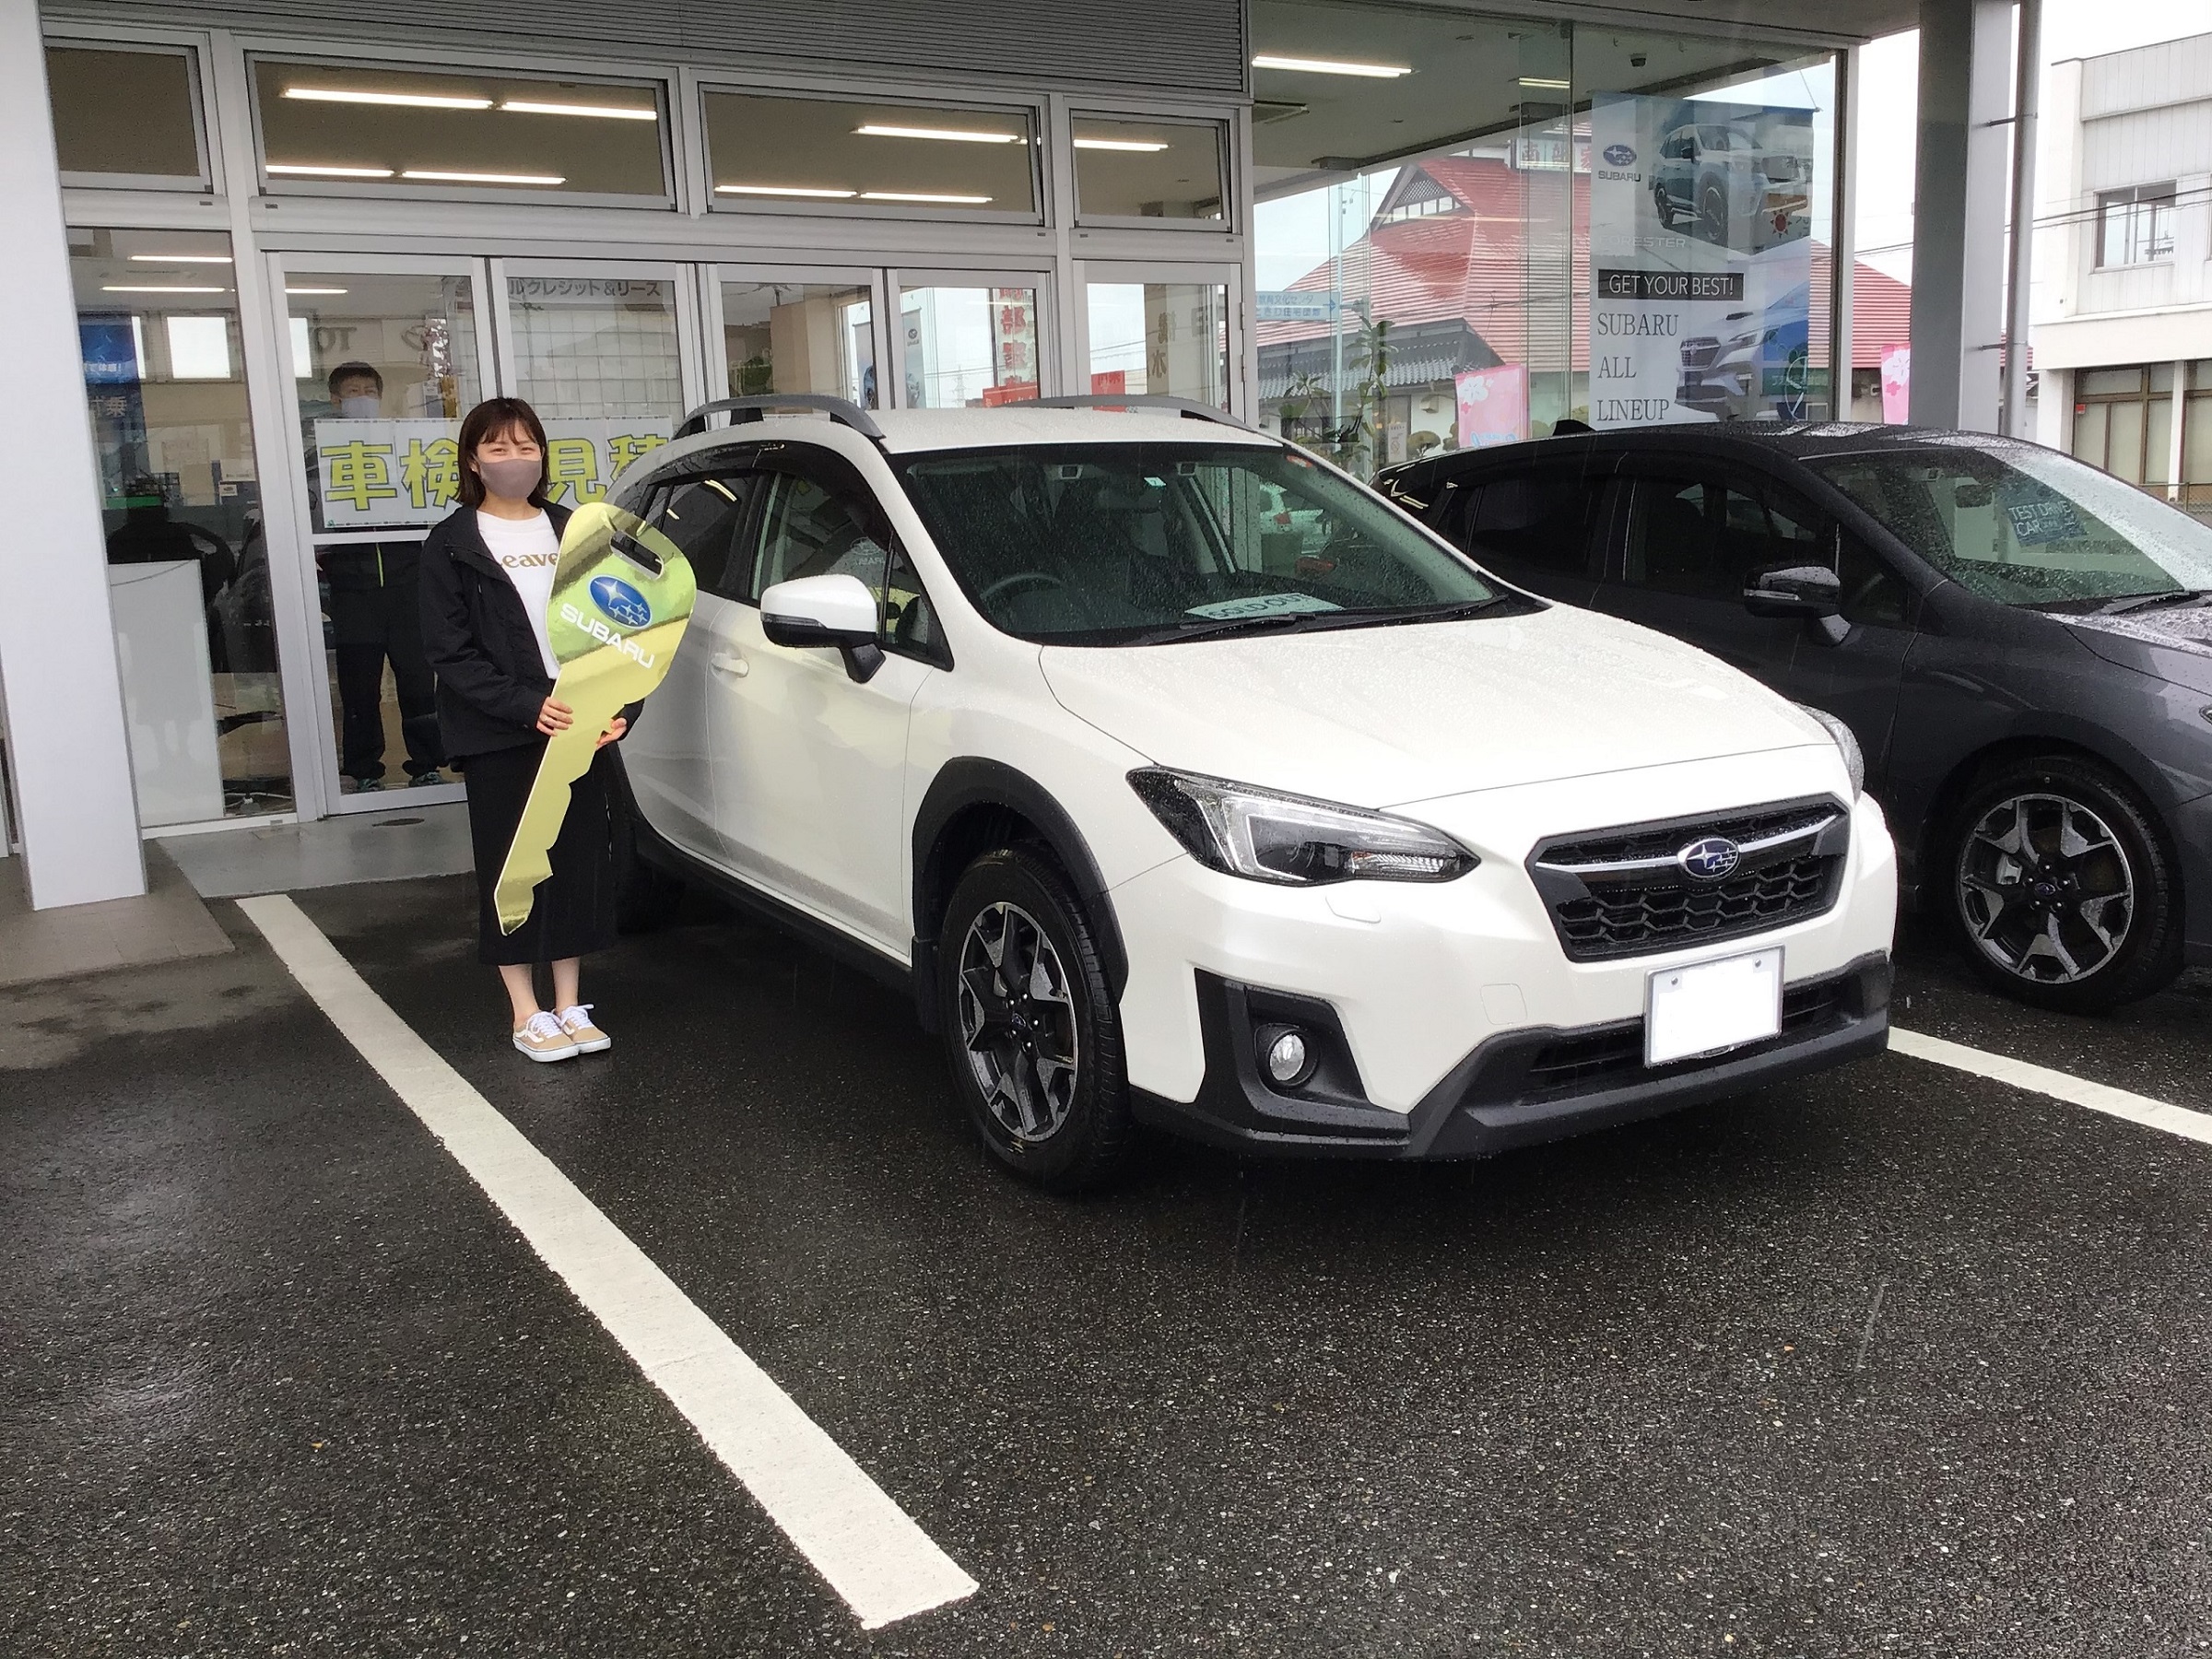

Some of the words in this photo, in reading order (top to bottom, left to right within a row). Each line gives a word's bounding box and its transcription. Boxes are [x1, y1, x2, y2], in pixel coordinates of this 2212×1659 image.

[1598, 170, 1641, 182] SUBARU
[1600, 235, 1686, 249] FORESTER
[1609, 275, 1641, 294] GET
[1644, 276, 1688, 295] YOUR
[1692, 277, 1734, 296] BEST!
[1597, 312, 1678, 336] SUBARU
[1597, 356, 1637, 379] ALL
[1596, 398, 1669, 422] LINEUP
[2007, 504, 2038, 521] TEST
[2016, 519, 2044, 536] CAR
[500, 552, 559, 569] eave
[1208, 602, 1268, 618] SOLD
[559, 603, 655, 669] SUBARU
